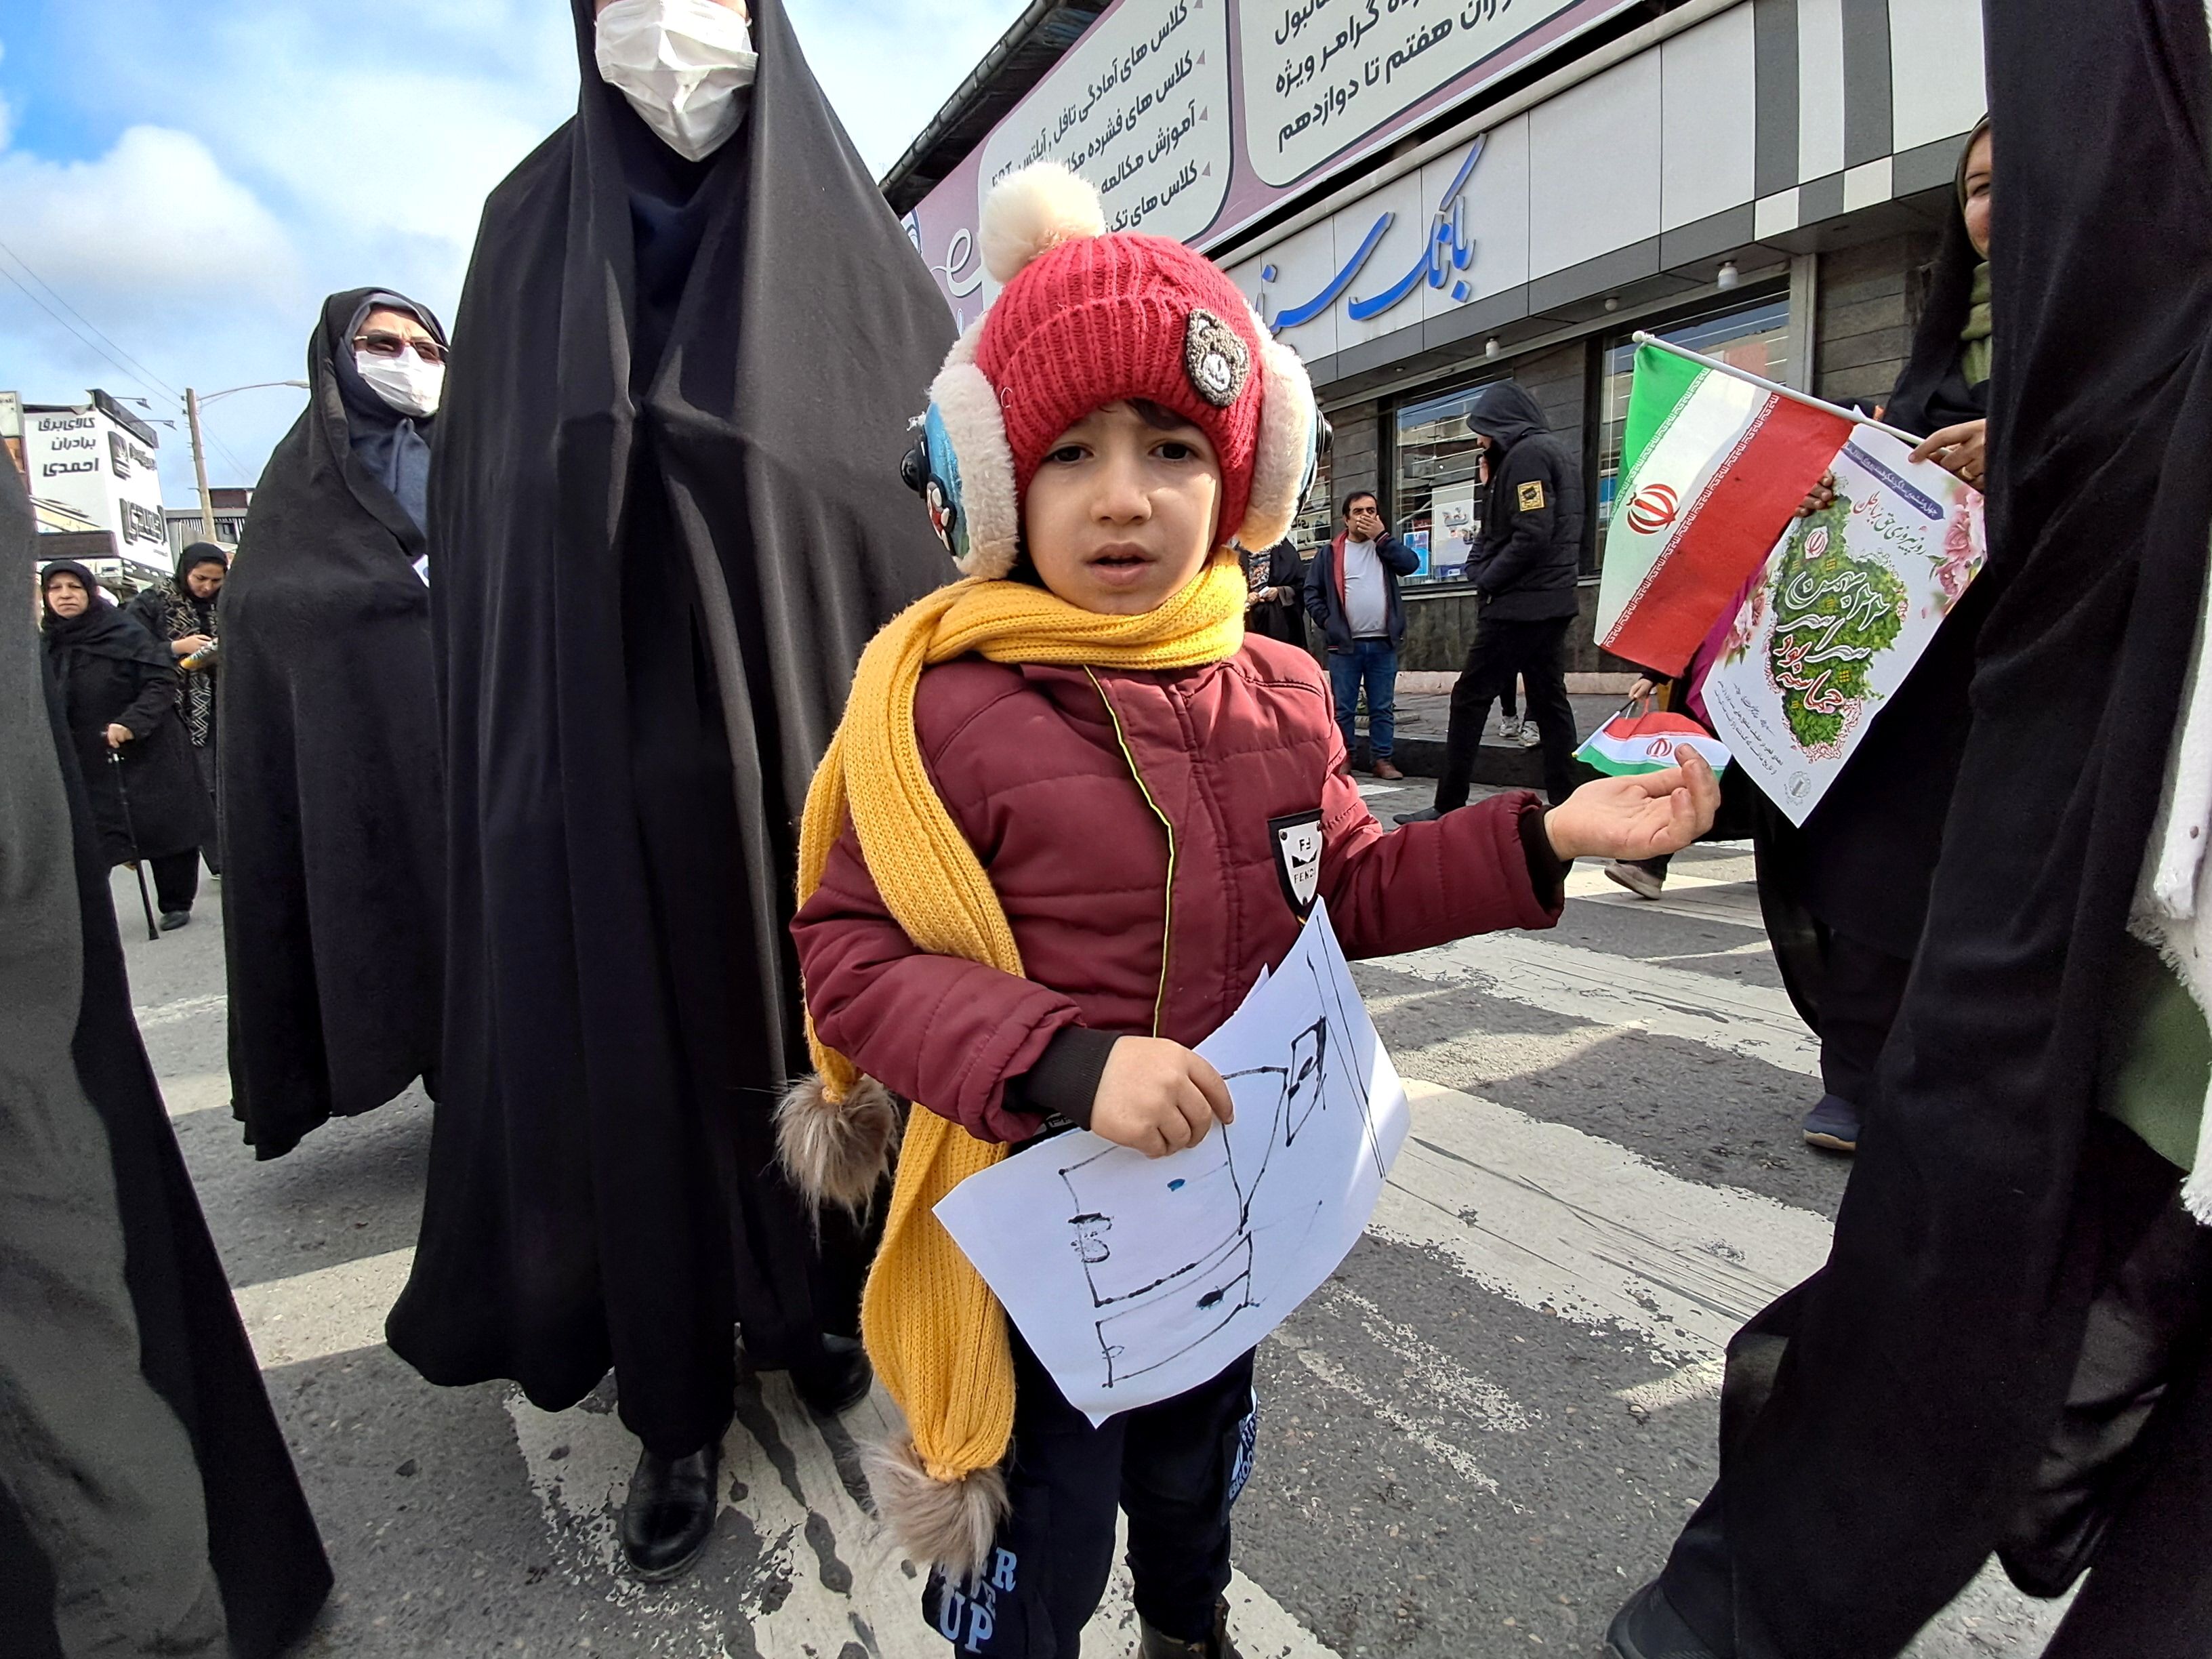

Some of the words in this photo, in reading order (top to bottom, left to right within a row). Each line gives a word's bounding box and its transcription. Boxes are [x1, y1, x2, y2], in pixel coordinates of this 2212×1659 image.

[1151, 0, 1187, 52] کلاس
[1320, 0, 1380, 73] گرامر
[1120, 43, 1147, 83] های
[1365, 56, 1380, 86] تا
[1386, 18, 1452, 84] هفتم
[1079, 57, 1118, 123] آمادگی
[1156, 49, 1193, 103] کلاس
[1275, 58, 1315, 98] ویژه
[1126, 93, 1152, 131] های
[1148, 98, 1195, 163] آموزش
[1279, 79, 1359, 153] دوازدهم
[1088, 108, 1123, 157] فشرده
[1101, 155, 1143, 194] مکالمه
[1161, 159, 1197, 206] کلاس
[1130, 195, 1158, 228] های
[38, 417, 63, 432] برق
[51, 436, 96, 451] برادران
[64, 417, 95, 430] کالای
[43, 457, 99, 477] احمدی
[1785, 571, 1868, 610] بهمن
